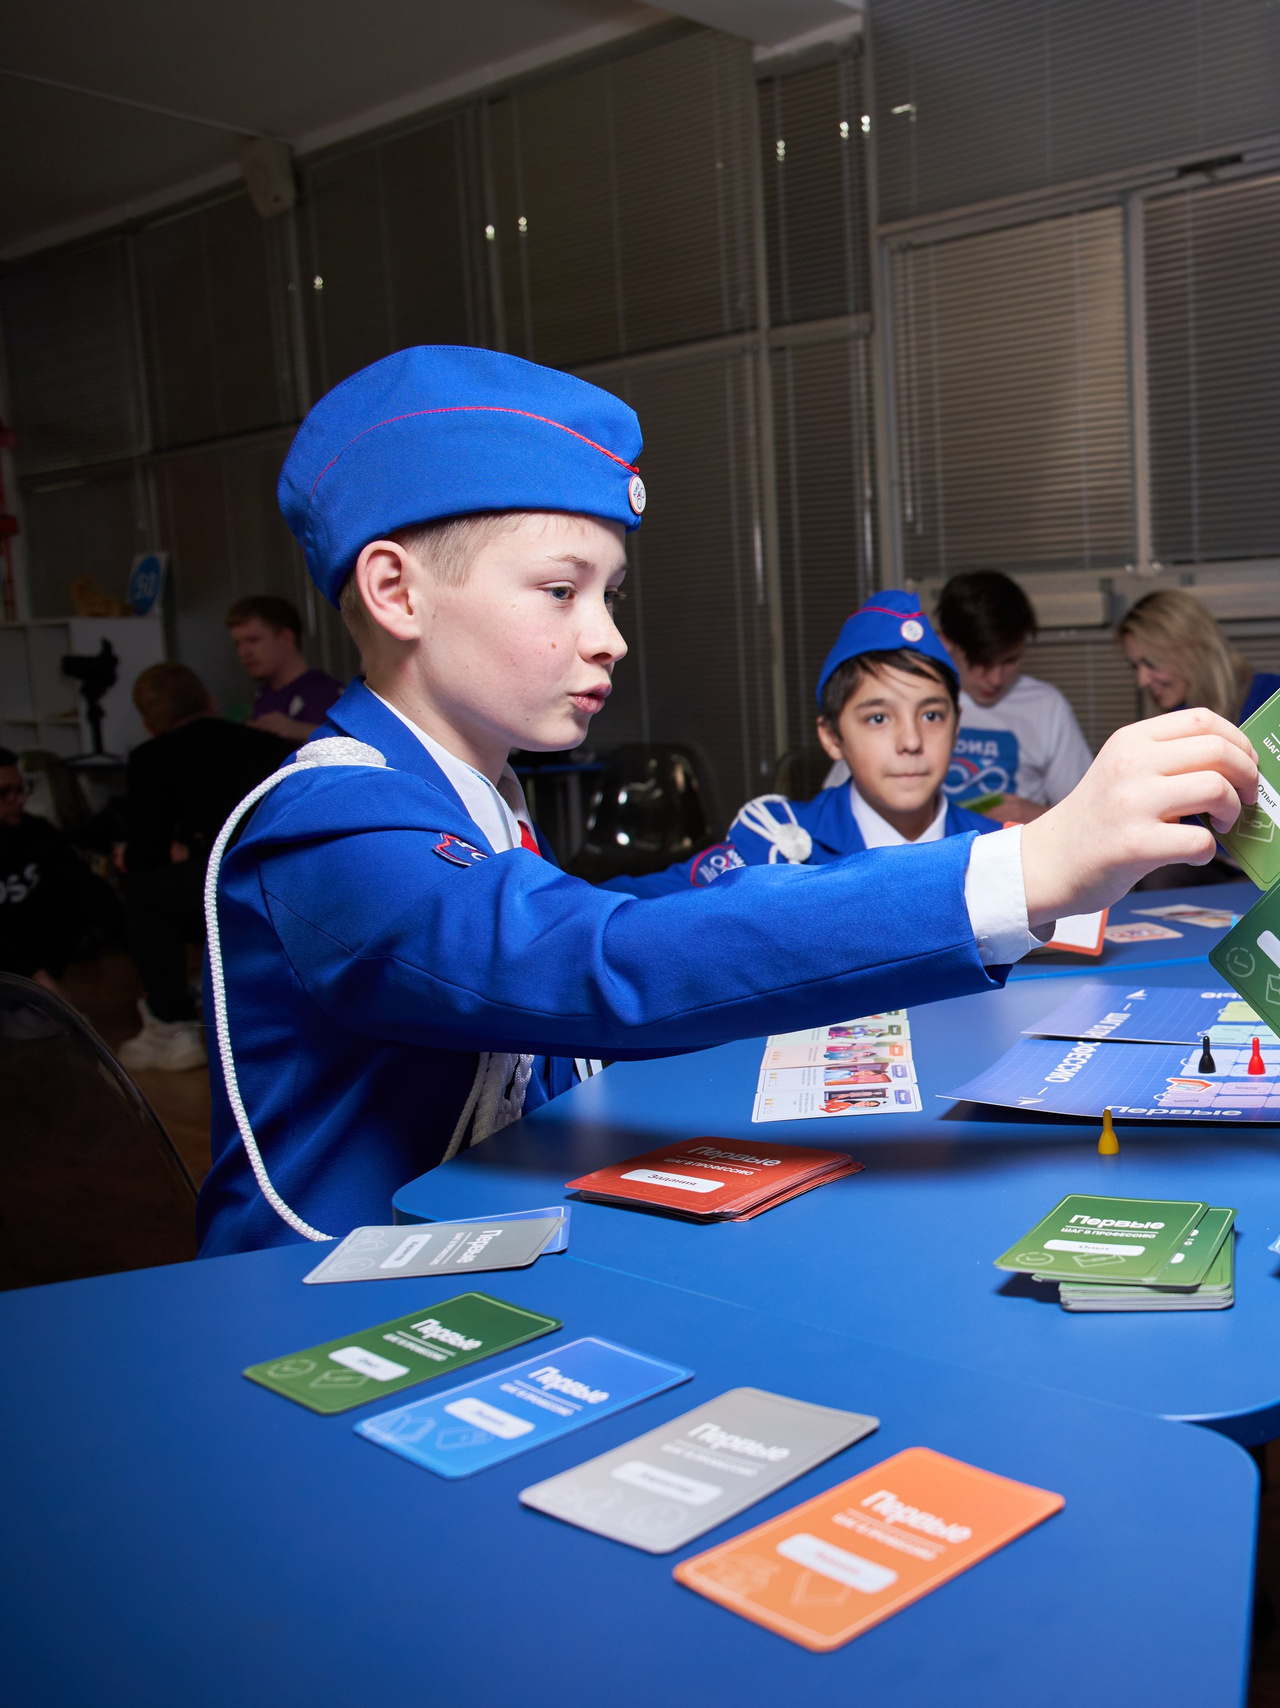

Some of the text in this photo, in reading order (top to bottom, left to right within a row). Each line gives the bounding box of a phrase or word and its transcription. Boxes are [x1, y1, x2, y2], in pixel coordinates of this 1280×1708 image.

[1263, 737, 1280, 754] ШАГ
[1258, 784, 1277, 808] Опыт
[0, 862, 39, 905] SS
[687, 1146, 782, 1168] Первые
[647, 1173, 698, 1187] Задания
[1069, 1215, 1165, 1229] Первые
[410, 1318, 483, 1351] Первые
[527, 1366, 610, 1404] Первые
[688, 1422, 790, 1461] Первые
[861, 1490, 972, 1544] Первые
